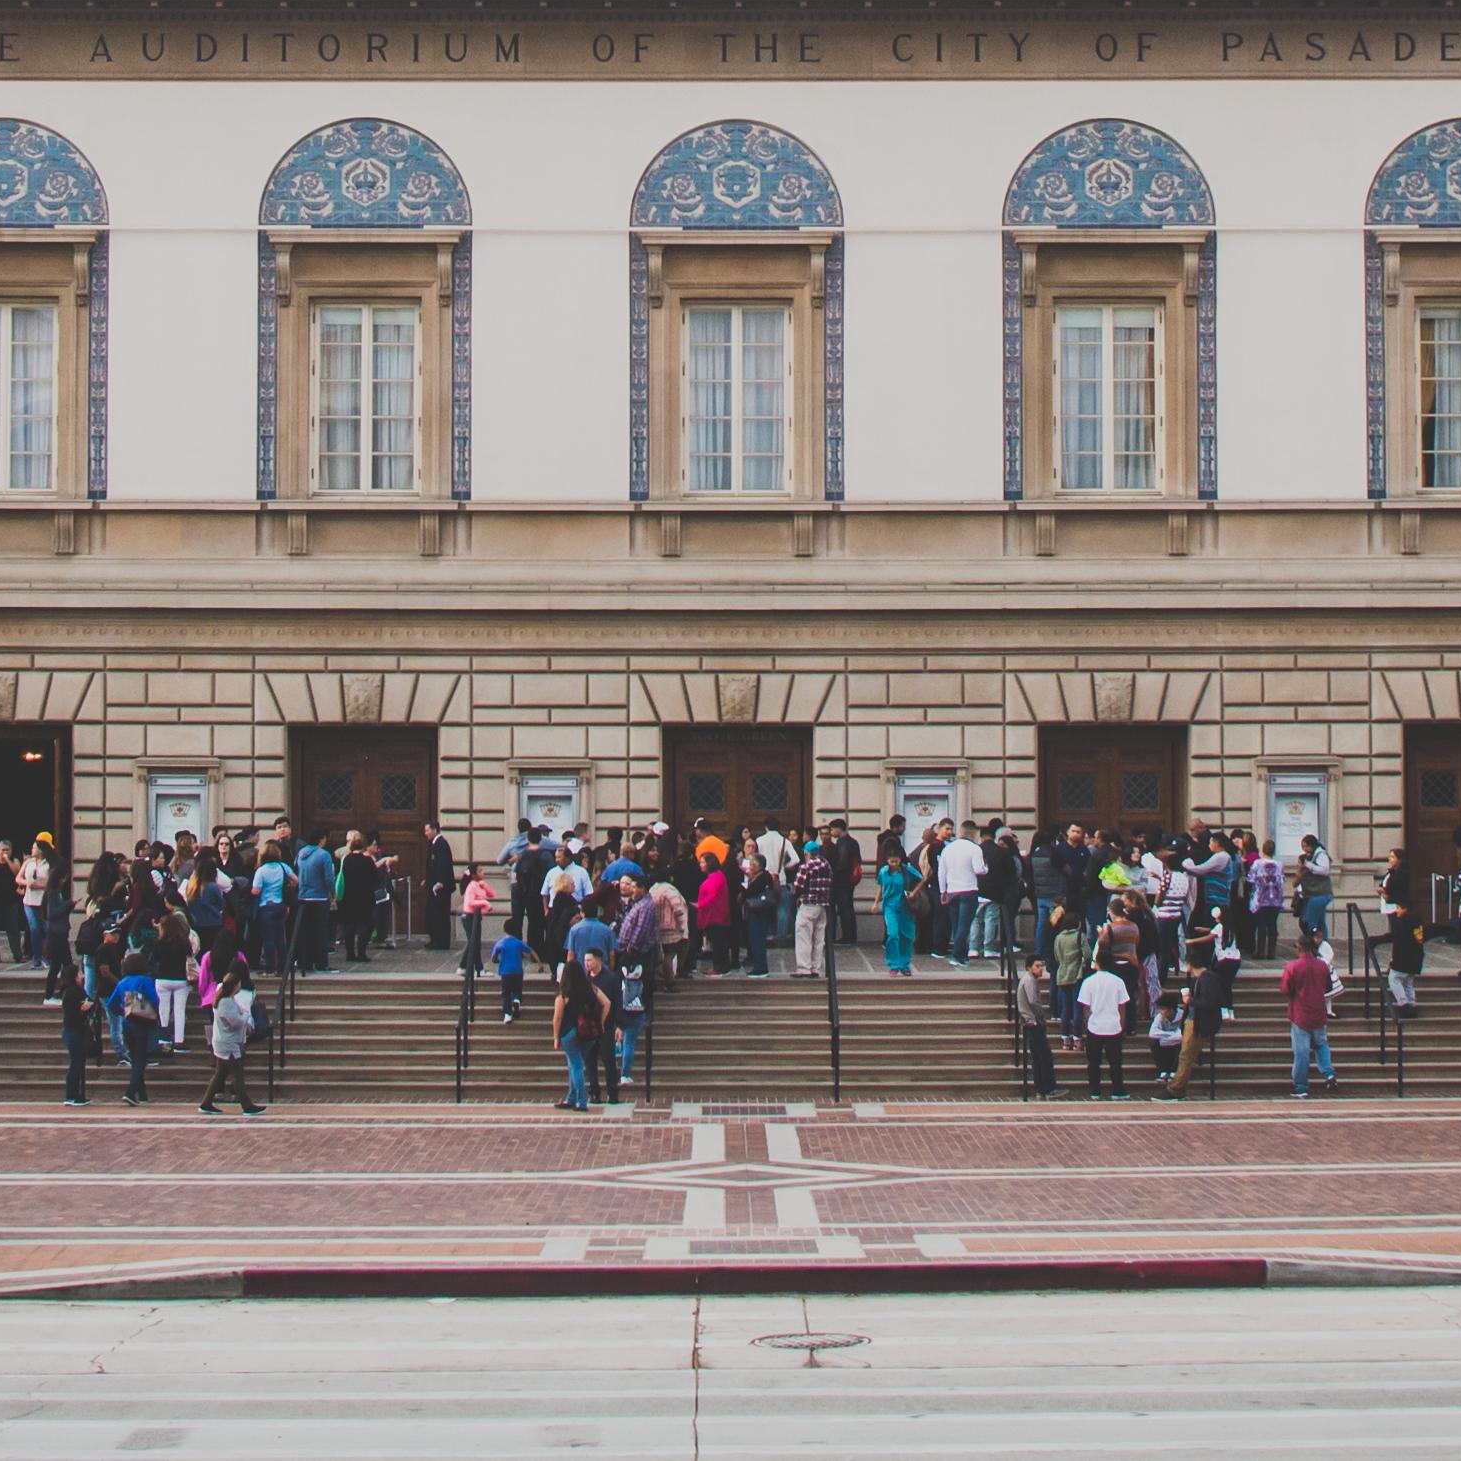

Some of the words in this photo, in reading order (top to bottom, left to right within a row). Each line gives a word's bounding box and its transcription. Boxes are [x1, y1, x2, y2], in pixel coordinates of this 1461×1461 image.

[89, 33, 524, 63] AUDITORIUM
[592, 33, 656, 63] OF
[715, 33, 822, 63] THE
[892, 33, 1034, 63] CITY
[1095, 33, 1158, 63] OF
